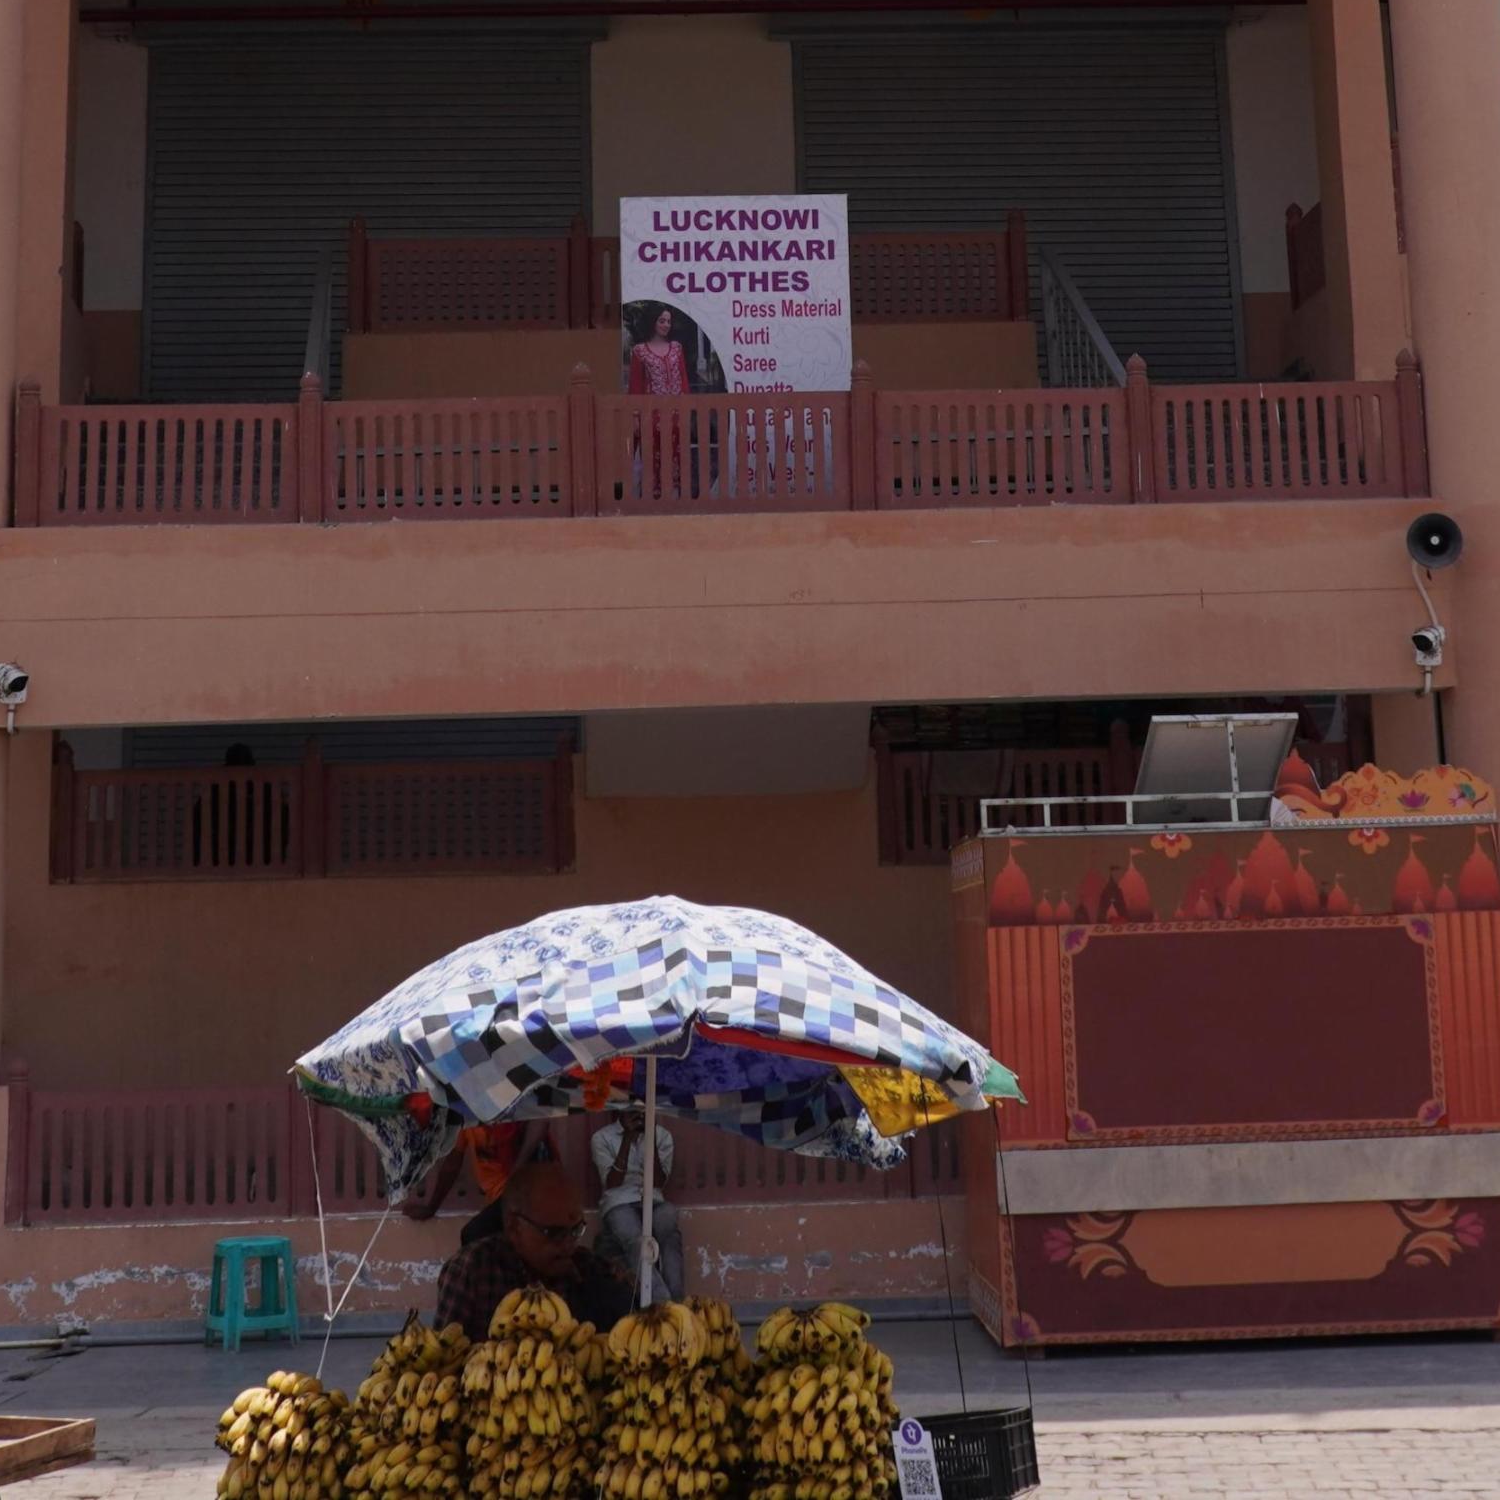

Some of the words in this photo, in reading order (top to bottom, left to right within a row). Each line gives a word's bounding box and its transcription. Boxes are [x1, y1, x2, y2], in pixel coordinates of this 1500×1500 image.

[653, 209, 819, 232] LUCKNOWI
[638, 239, 835, 263] CHIKANKARI
[665, 271, 809, 293] CLOTHES
[732, 301, 776, 318] Dress
[780, 299, 842, 317] Material
[732, 327, 770, 345] Kurti
[733, 354, 777, 373] Saree
